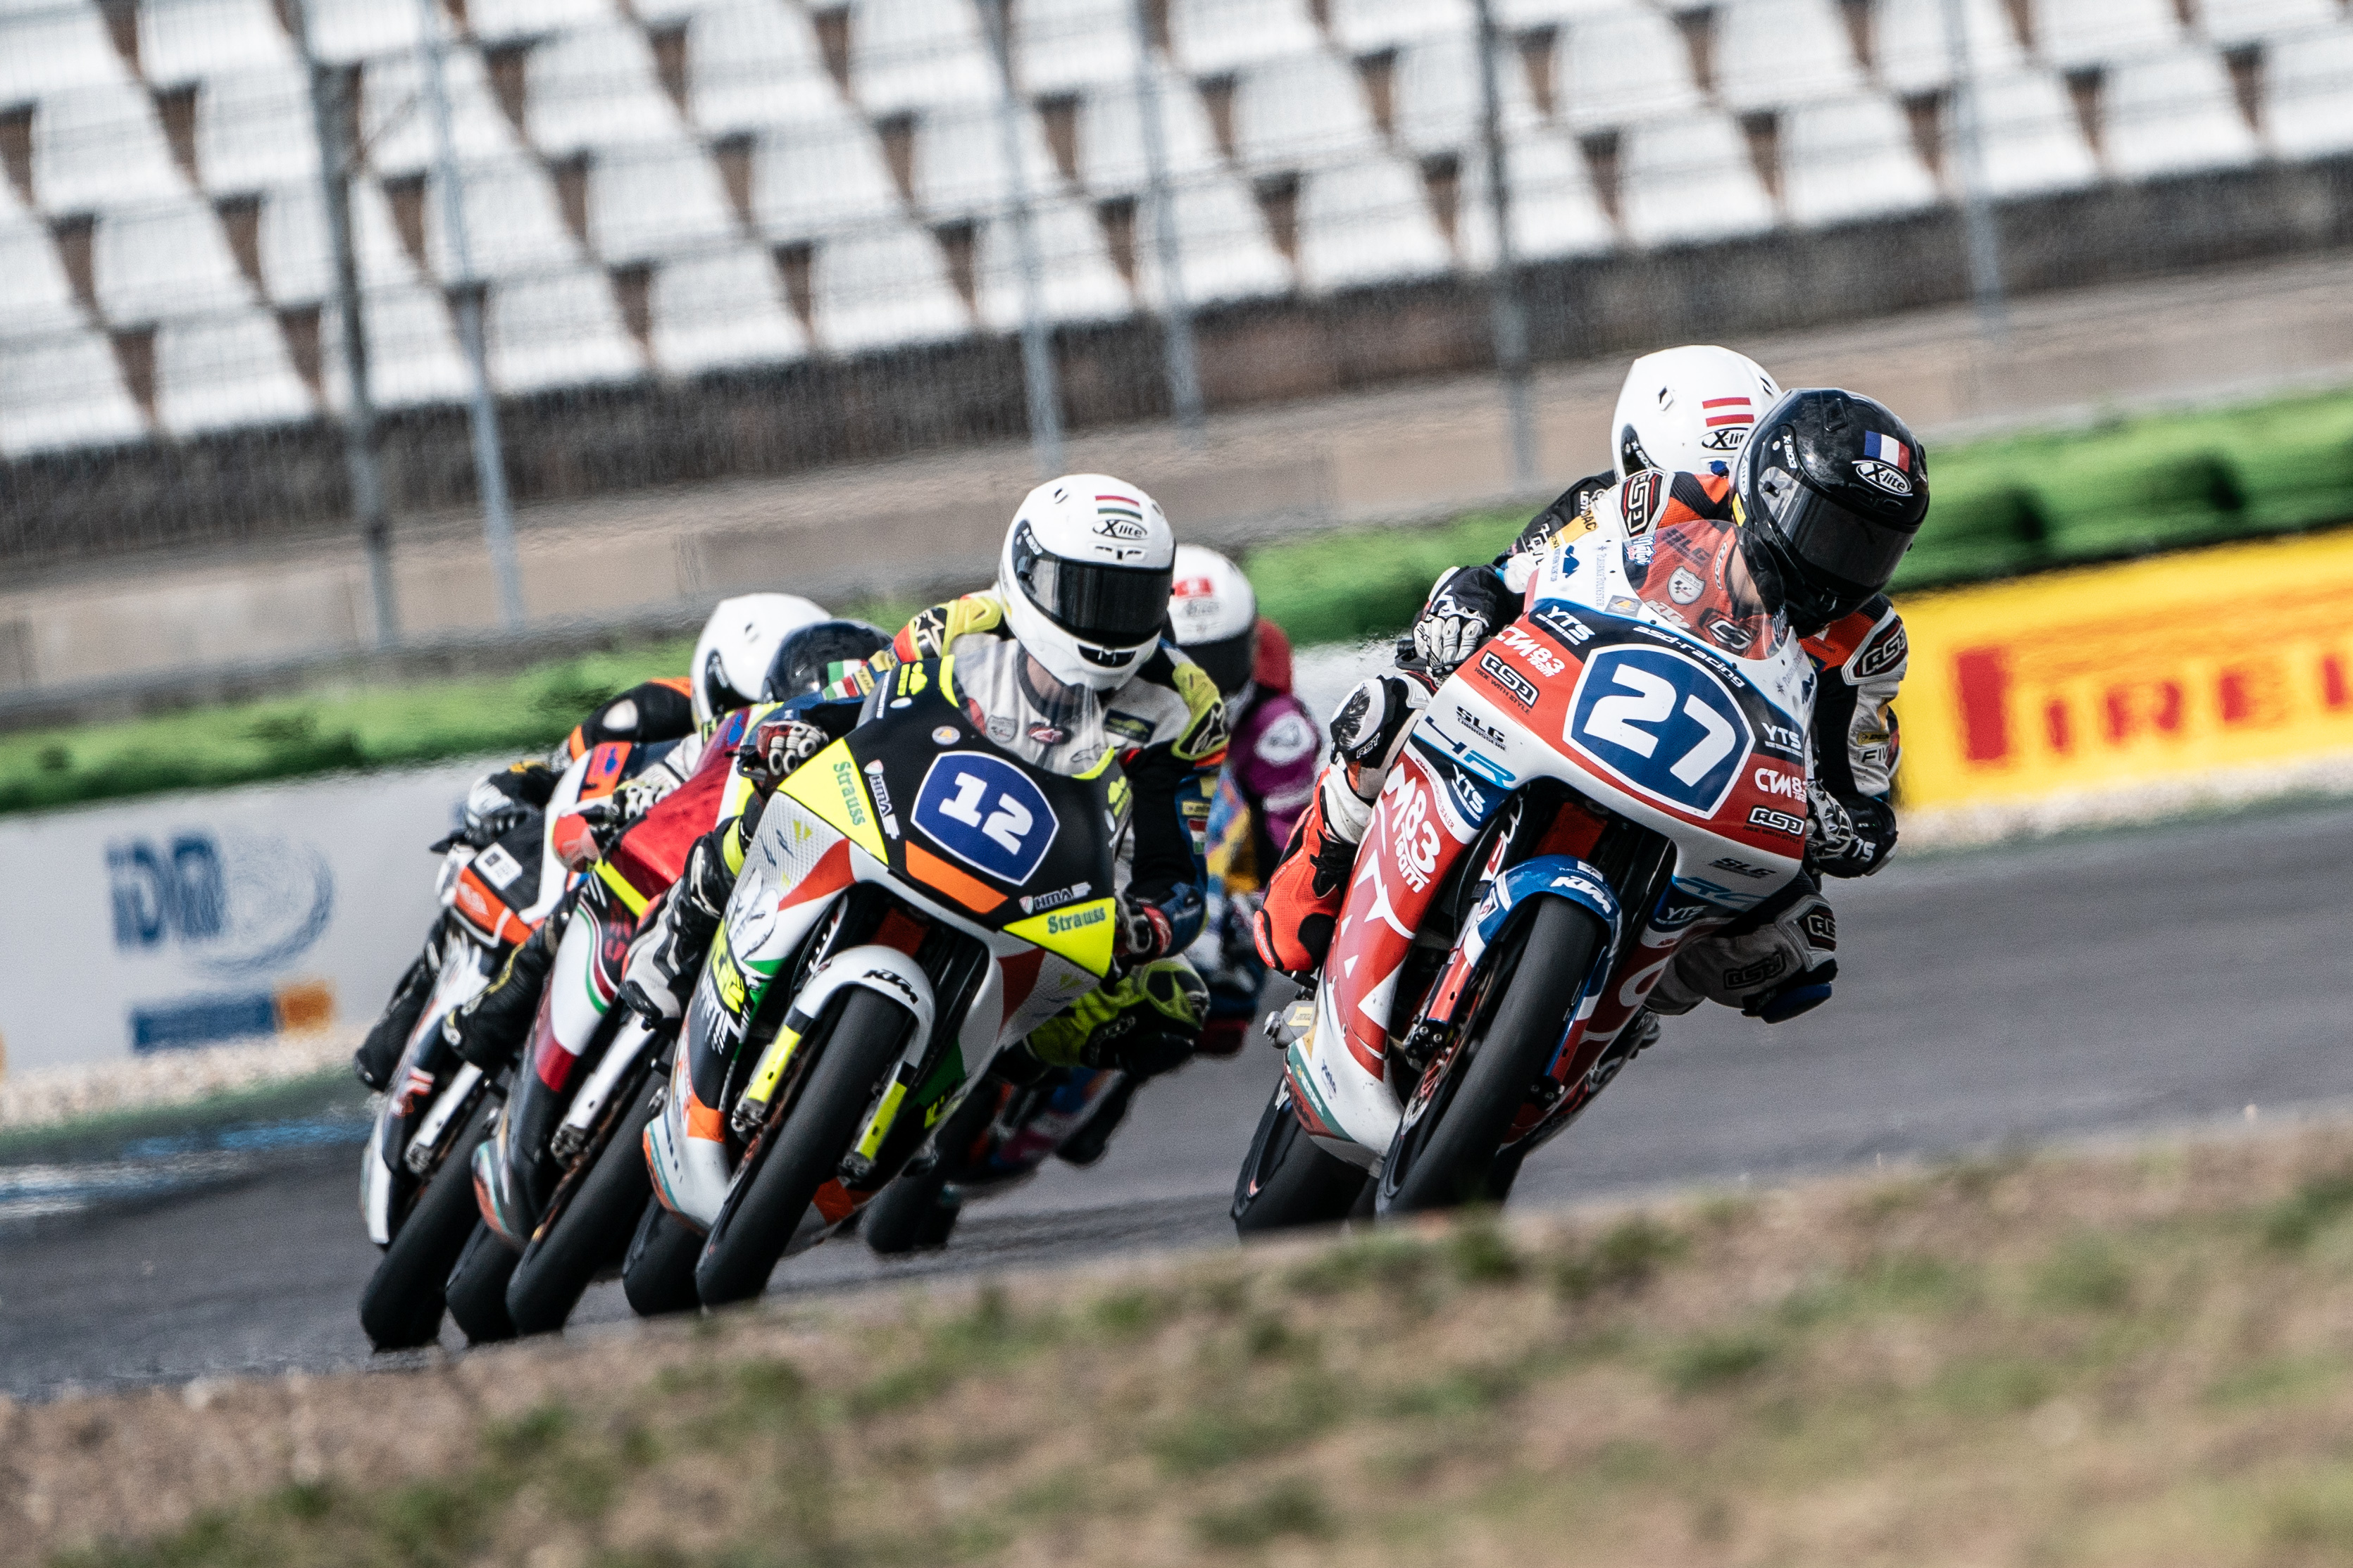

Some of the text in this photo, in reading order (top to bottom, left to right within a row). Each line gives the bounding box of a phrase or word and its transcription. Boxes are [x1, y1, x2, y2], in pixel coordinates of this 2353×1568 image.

[1707, 429, 1747, 449] X-lit
[1863, 463, 1906, 491] X-lite
[1100, 520, 1144, 539] X-lite
[1547, 605, 1595, 641] YTS
[1633, 625, 1745, 688] asd-racing
[1456, 705, 1506, 743] SLG
[1583, 663, 1737, 787] 27
[1761, 722, 1802, 751] YTS
[1356, 732, 1381, 760] RST
[832, 761, 866, 827] Strauss
[1452, 764, 1487, 815] YTS
[938, 772, 1034, 855] 12
[1549, 875, 1612, 915] KTM
[1047, 907, 1107, 935] Strauss
[862, 969, 918, 1005] KTM
